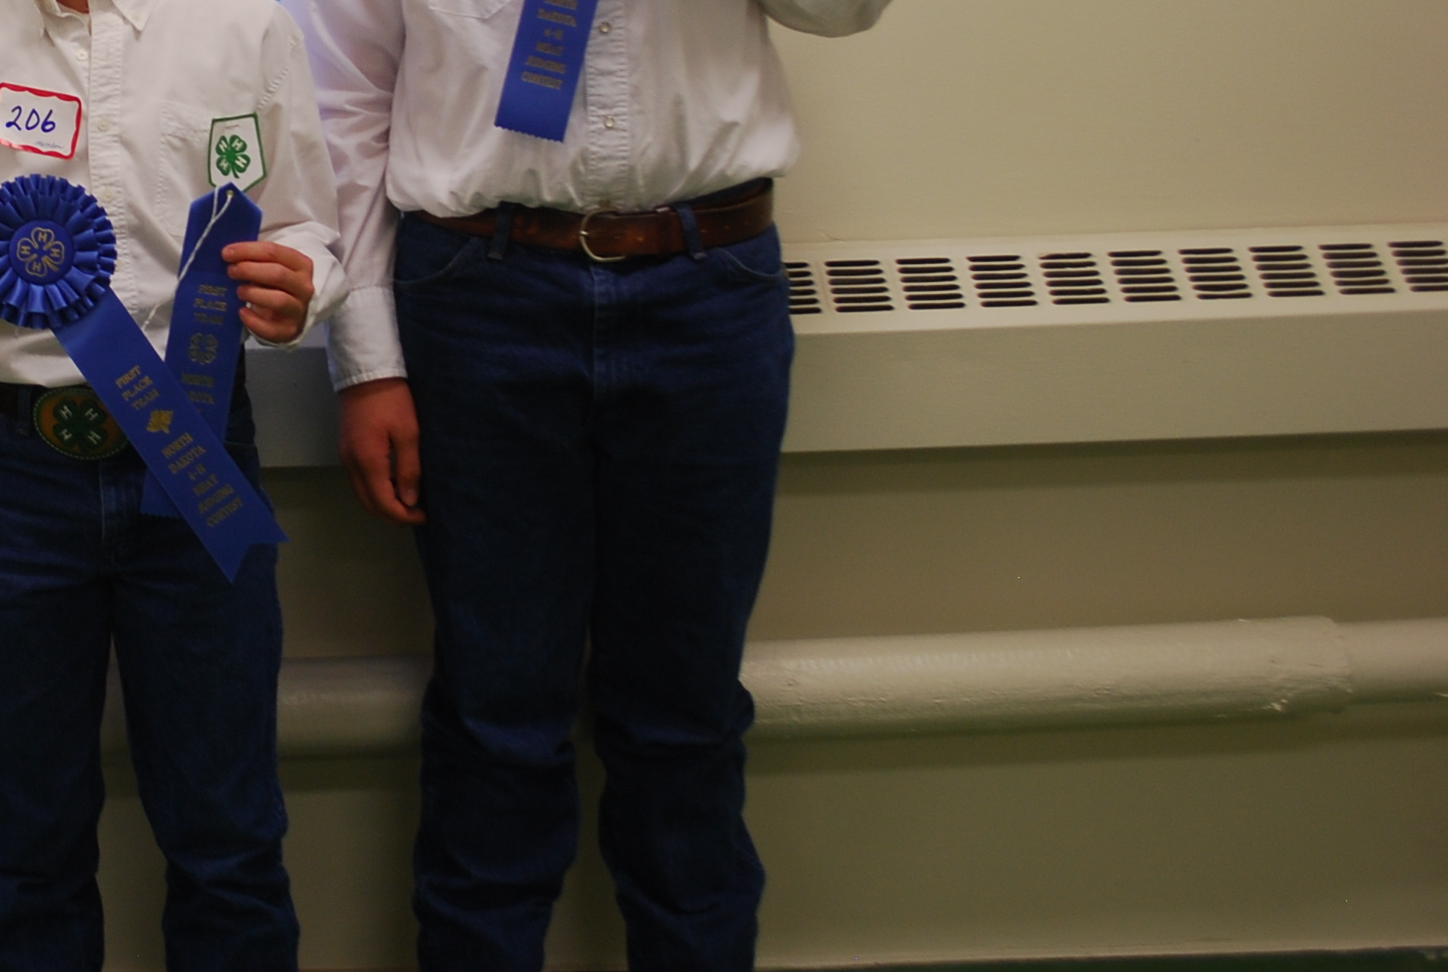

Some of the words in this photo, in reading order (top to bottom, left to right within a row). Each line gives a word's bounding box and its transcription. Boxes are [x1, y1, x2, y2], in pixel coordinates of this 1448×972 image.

[6, 105, 56, 133] 206
[198, 284, 227, 297] FIRST
[194, 298, 227, 311] PLACE
[116, 365, 141, 388] FIRST
[122, 376, 153, 401] PLACE
[132, 389, 160, 410] TEAM
[162, 432, 194, 458] NORTH
[169, 445, 206, 475] DAKOTA
[198, 484, 235, 514] JUDGING
[207, 497, 243, 527] CONTEST
